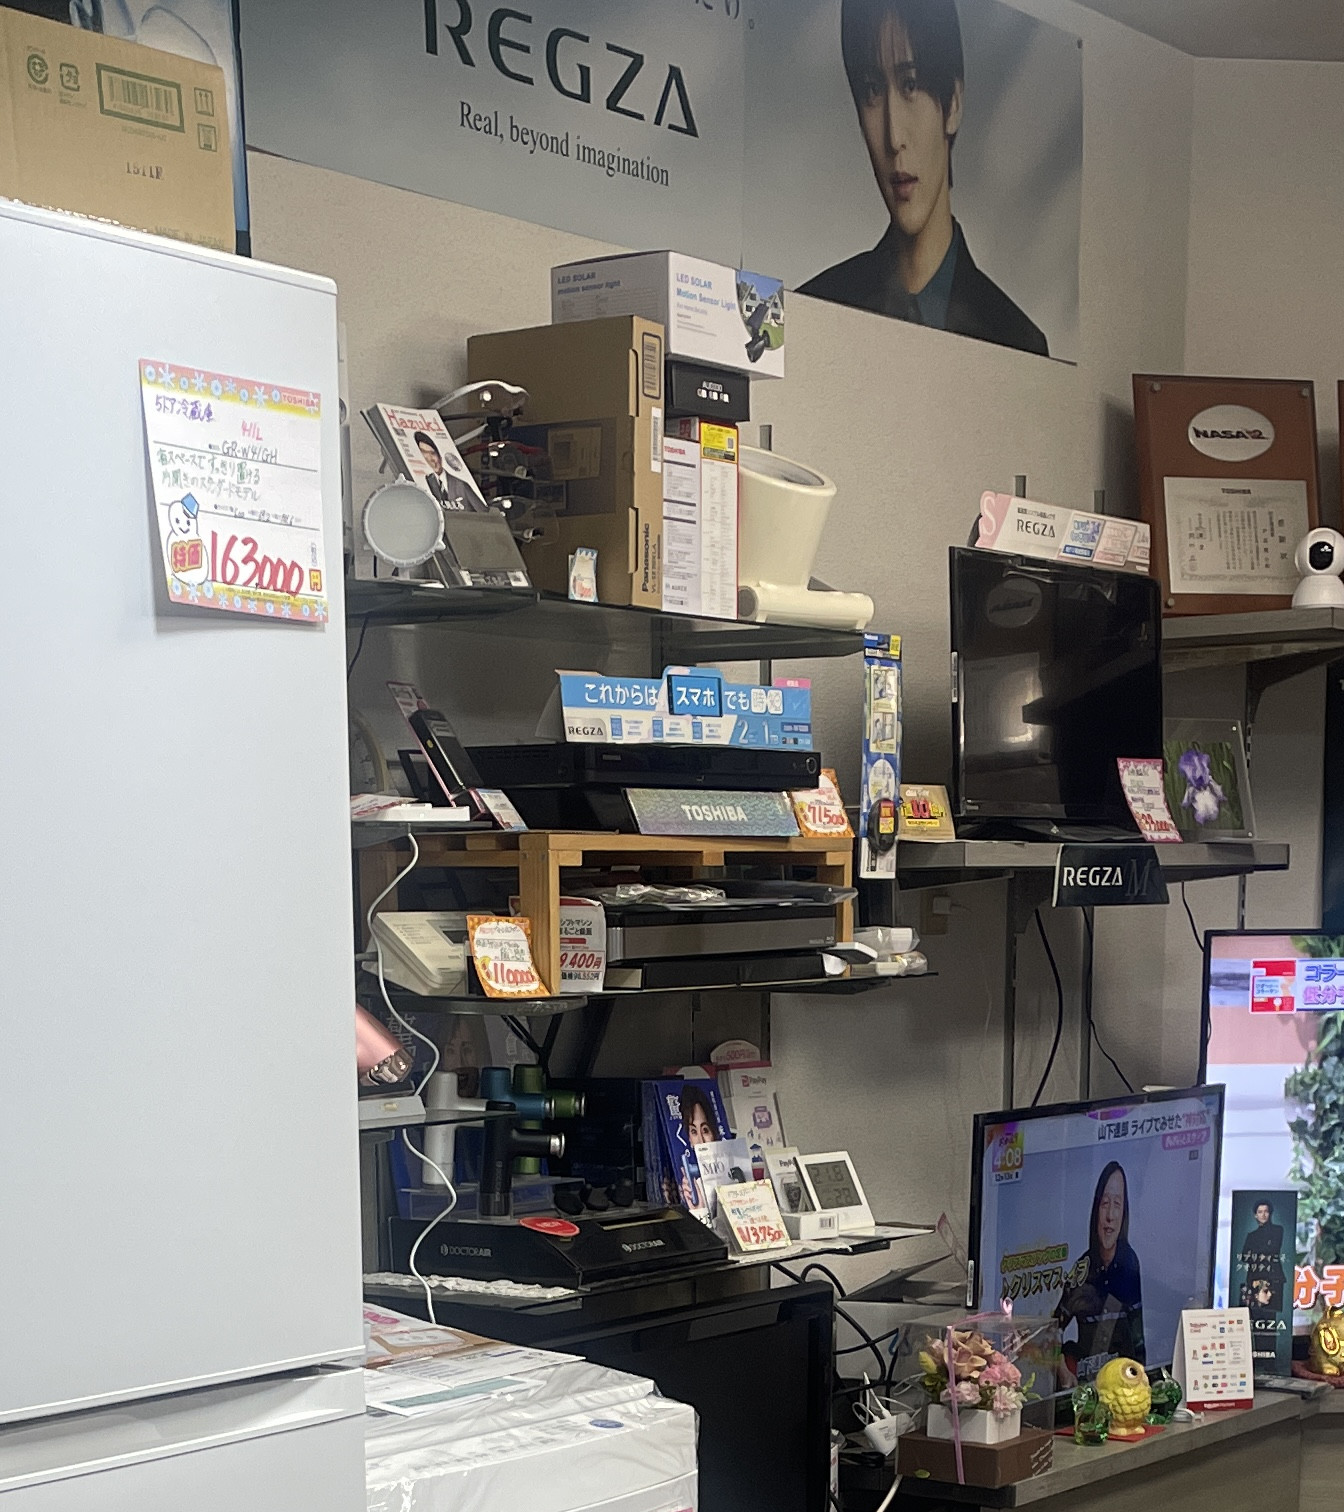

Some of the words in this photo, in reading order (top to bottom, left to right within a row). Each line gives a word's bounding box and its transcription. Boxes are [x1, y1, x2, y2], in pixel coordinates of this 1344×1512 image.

[423, 0, 701, 139] REGZA
[458, 101, 505, 143] Real,
[508, 113, 570, 163] beyond
[574, 130, 672, 188] imagination
[572, 272, 596, 283] SOLAR
[676, 273, 689, 284] LED
[690, 277, 712, 290] SOLAR
[676, 288, 697, 300] Motion
[698, 292, 720, 307] Sensor
[281, 394, 318, 409] TOSHIBA
[383, 407, 445, 432] Hazuki
[1016, 517, 1056, 539] REGZA
[172, 540, 203, 572] 特価
[641, 522, 650, 592] Panasonic
[584, 683, 658, 707] これからは
[676, 686, 716, 708] スマホ
[568, 725, 604, 737] REGZA
[681, 803, 749, 823] TOSHIBA
[1062, 865, 1124, 888] REGZA
[449, 1245, 492, 1257] DOCTORAIR
